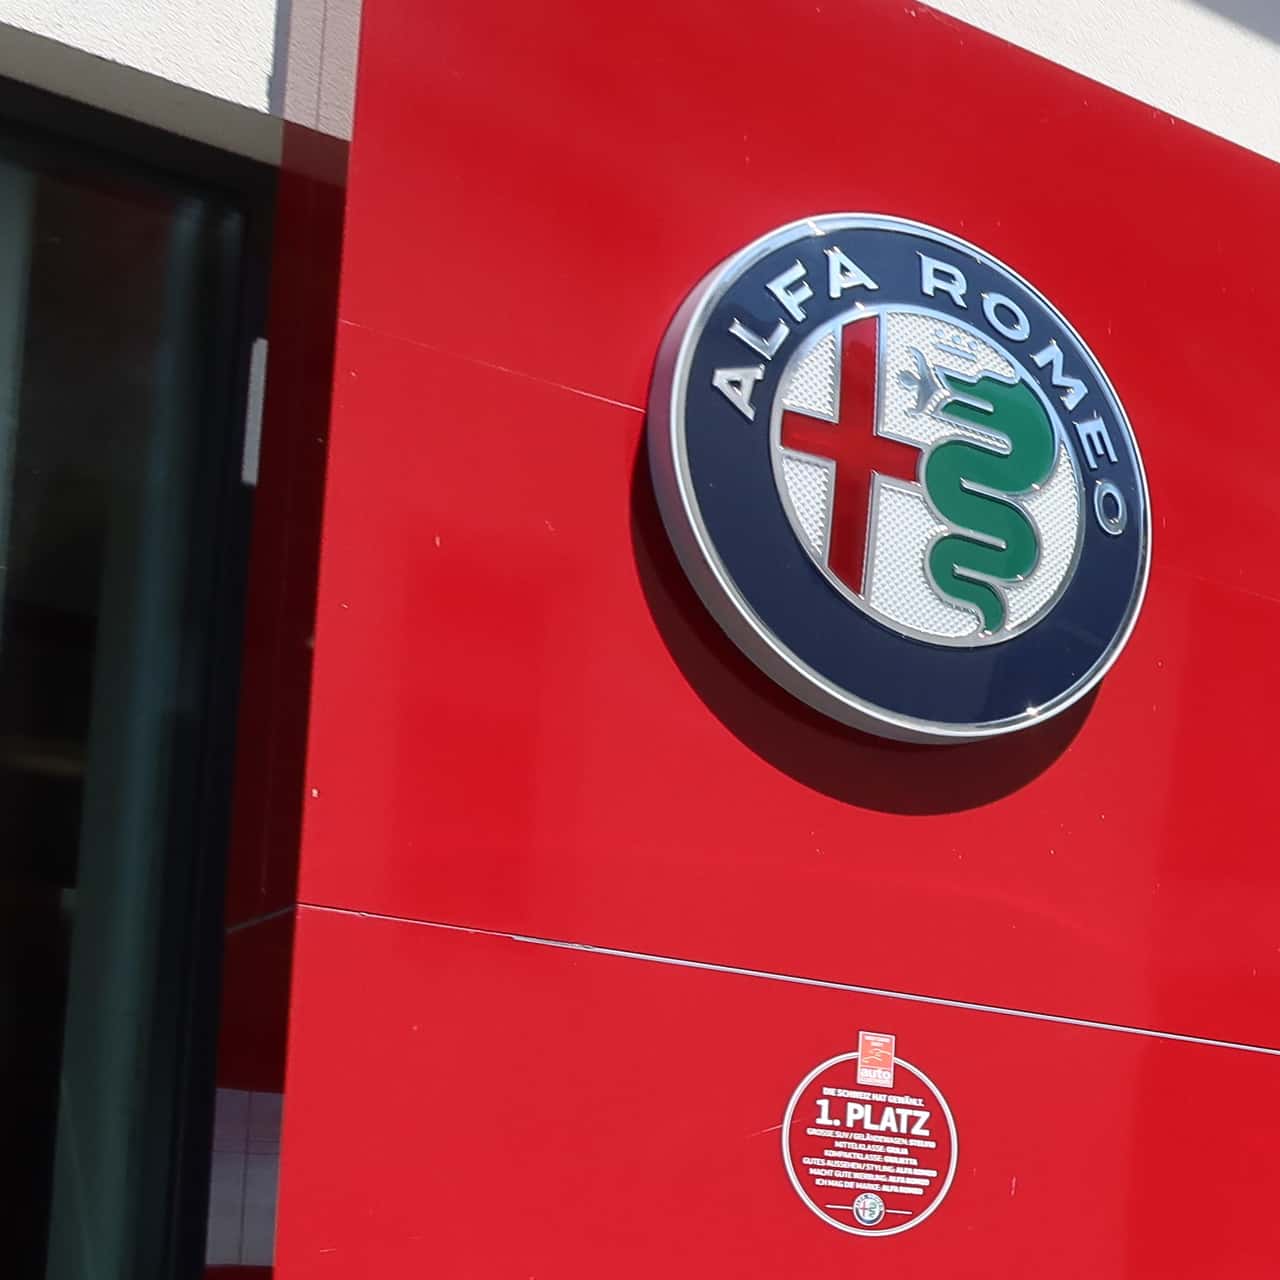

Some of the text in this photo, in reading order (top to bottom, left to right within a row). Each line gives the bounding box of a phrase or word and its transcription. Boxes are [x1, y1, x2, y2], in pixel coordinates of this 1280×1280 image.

[713, 246, 1126, 536] ALFA ROMEO
[815, 1098, 931, 1136] 1. PLATZ
